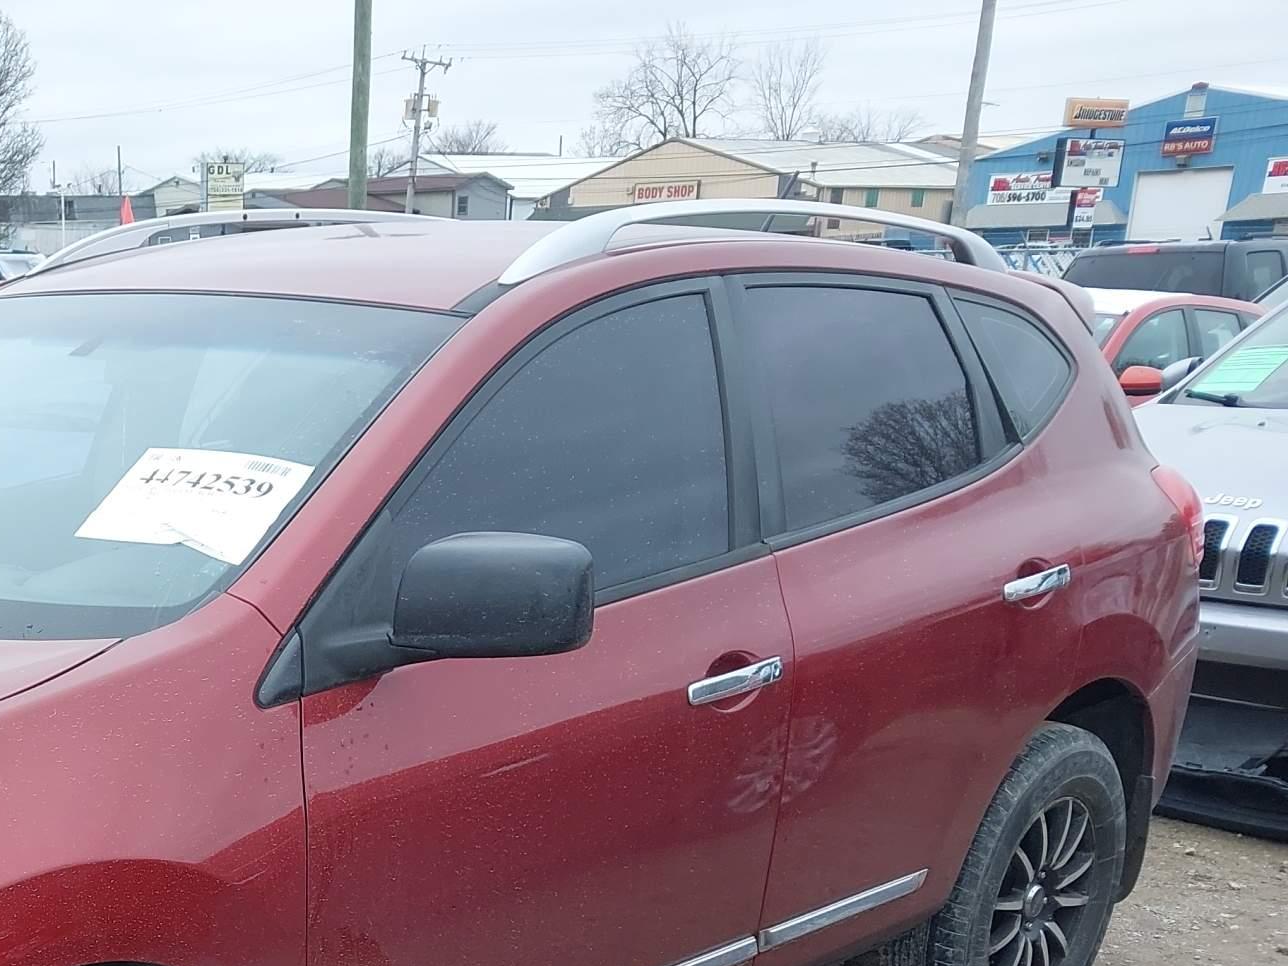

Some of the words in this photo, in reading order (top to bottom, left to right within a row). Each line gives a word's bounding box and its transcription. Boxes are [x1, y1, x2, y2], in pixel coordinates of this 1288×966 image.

[1074, 105, 1125, 121] BRIDGESTONE
[1184, 140, 1209, 151] AUTO
[208, 165, 231, 175] GDL
[637, 186, 664, 199] BODY
[667, 184, 695, 198] SHOP
[140, 468, 274, 498] 44742539
[1204, 493, 1263, 510] Jeep
